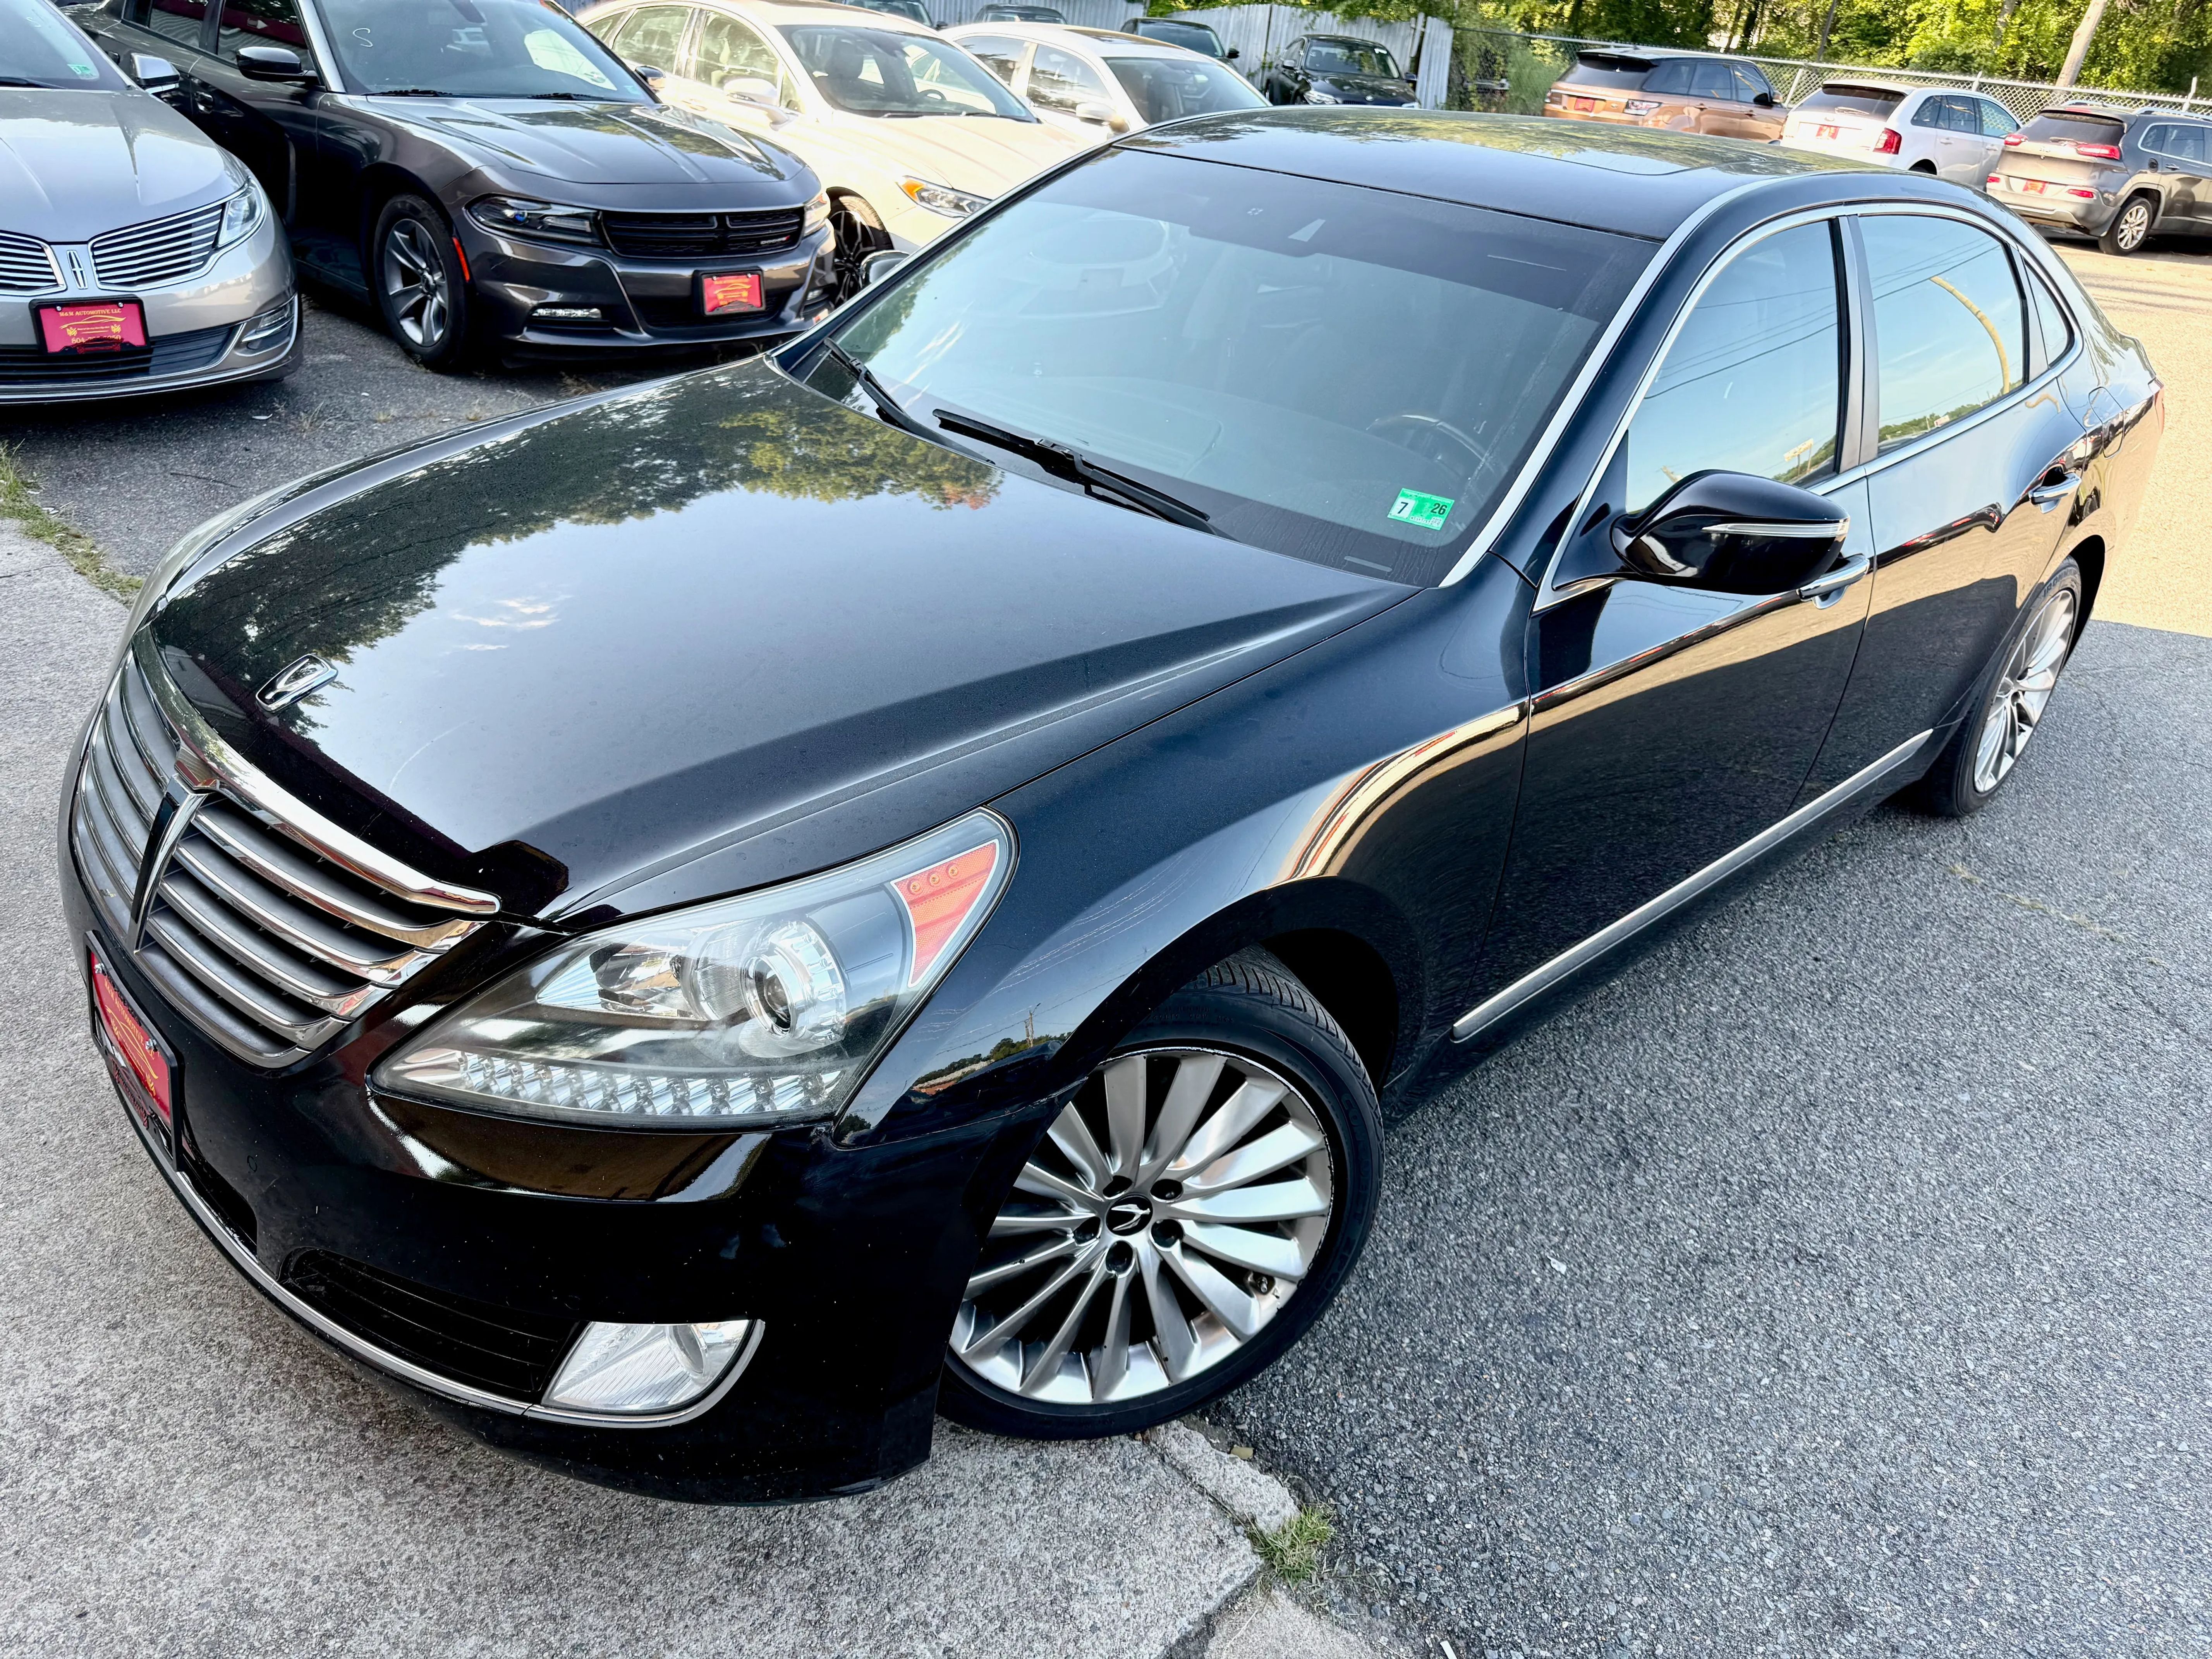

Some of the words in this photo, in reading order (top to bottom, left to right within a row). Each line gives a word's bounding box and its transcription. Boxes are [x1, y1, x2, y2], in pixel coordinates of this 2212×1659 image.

[352, 28, 373, 47] S
[1397, 501, 1408, 514] 7
[1430, 503, 1448, 515] 26
